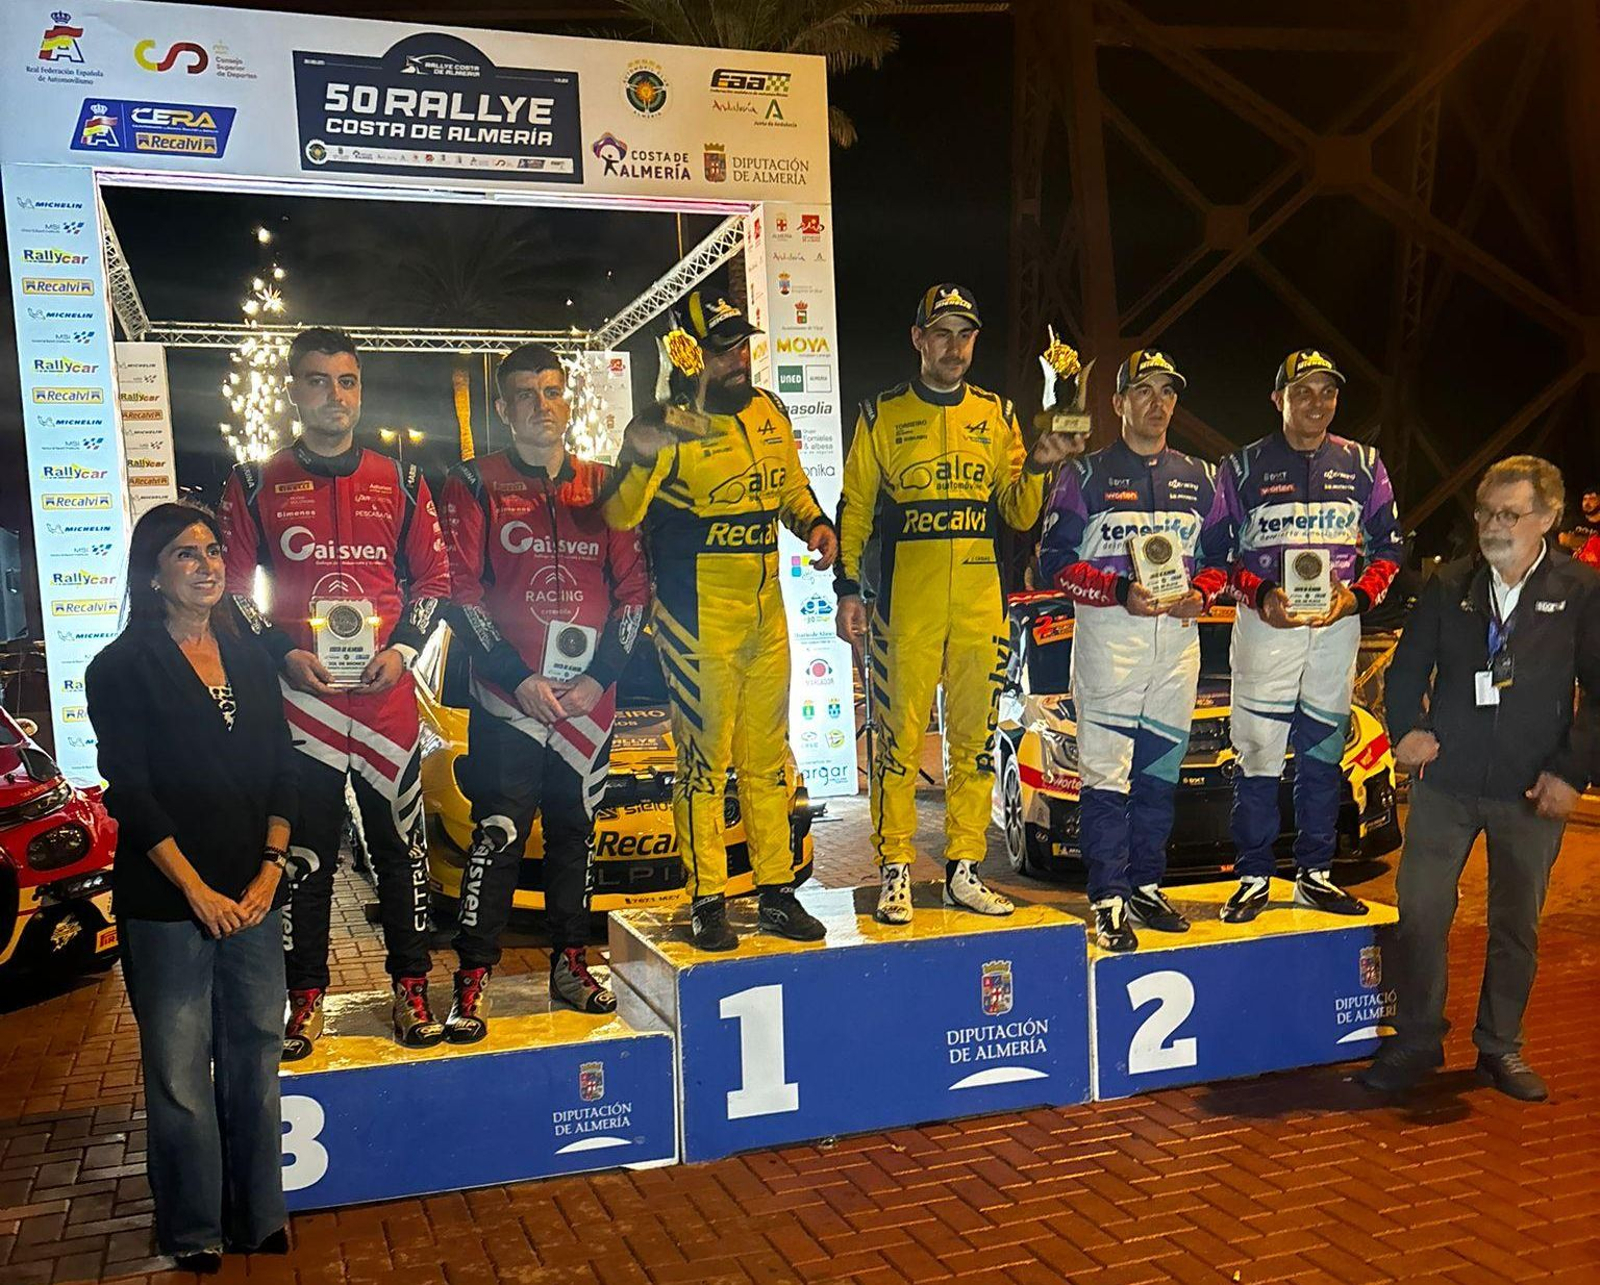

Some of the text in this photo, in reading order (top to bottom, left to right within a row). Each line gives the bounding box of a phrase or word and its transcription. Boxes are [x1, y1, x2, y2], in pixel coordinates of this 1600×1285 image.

[26, 65, 39, 73] Real
[41, 66, 74, 75] Federación
[324, 83, 554, 125] 50 RALLYE
[131, 107, 217, 128] CERA
[326, 118, 553, 147] COSTA DE ALMERÍA
[151, 135, 202, 150] Recalvi
[631, 150, 689, 164] COSTA DE
[732, 156, 809, 172] DIPUTACIÓN
[620, 164, 691, 181] ALMERÍA
[733, 171, 807, 186] DE ALMERÍA
[23, 249, 88, 264] Rallycar
[37, 281, 80, 293] Recalvi
[776, 337, 829, 352] MOYA
[34, 359, 99, 373] Rallycar
[47, 390, 90, 402] Recalvi
[120, 393, 160, 403] Rallycar
[127, 459, 165, 468] Rallycar
[936, 455, 986, 482] alca
[43, 465, 108, 479] Rallycar
[56, 496, 98, 507] Recalvi
[902, 506, 987, 533] Recalvi
[53, 573, 116, 586] Rallycar
[525, 590, 584, 602] RACING
[66, 602, 107, 613] Recalvi
[1335, 988, 1398, 1010] DIPUTACIÓ
[1126, 970, 1197, 1074] 2
[1337, 1011, 1353, 1025] DE
[946, 1018, 1049, 1046] DIPUTACIÓN
[719, 984, 799, 1120] 1
[949, 1036, 1047, 1064] DE ALMERÍA
[552, 1102, 632, 1125] DIPUTACIÓN
[554, 1115, 631, 1136] DE ALMERÍA
[280, 1095, 329, 1192] 3
